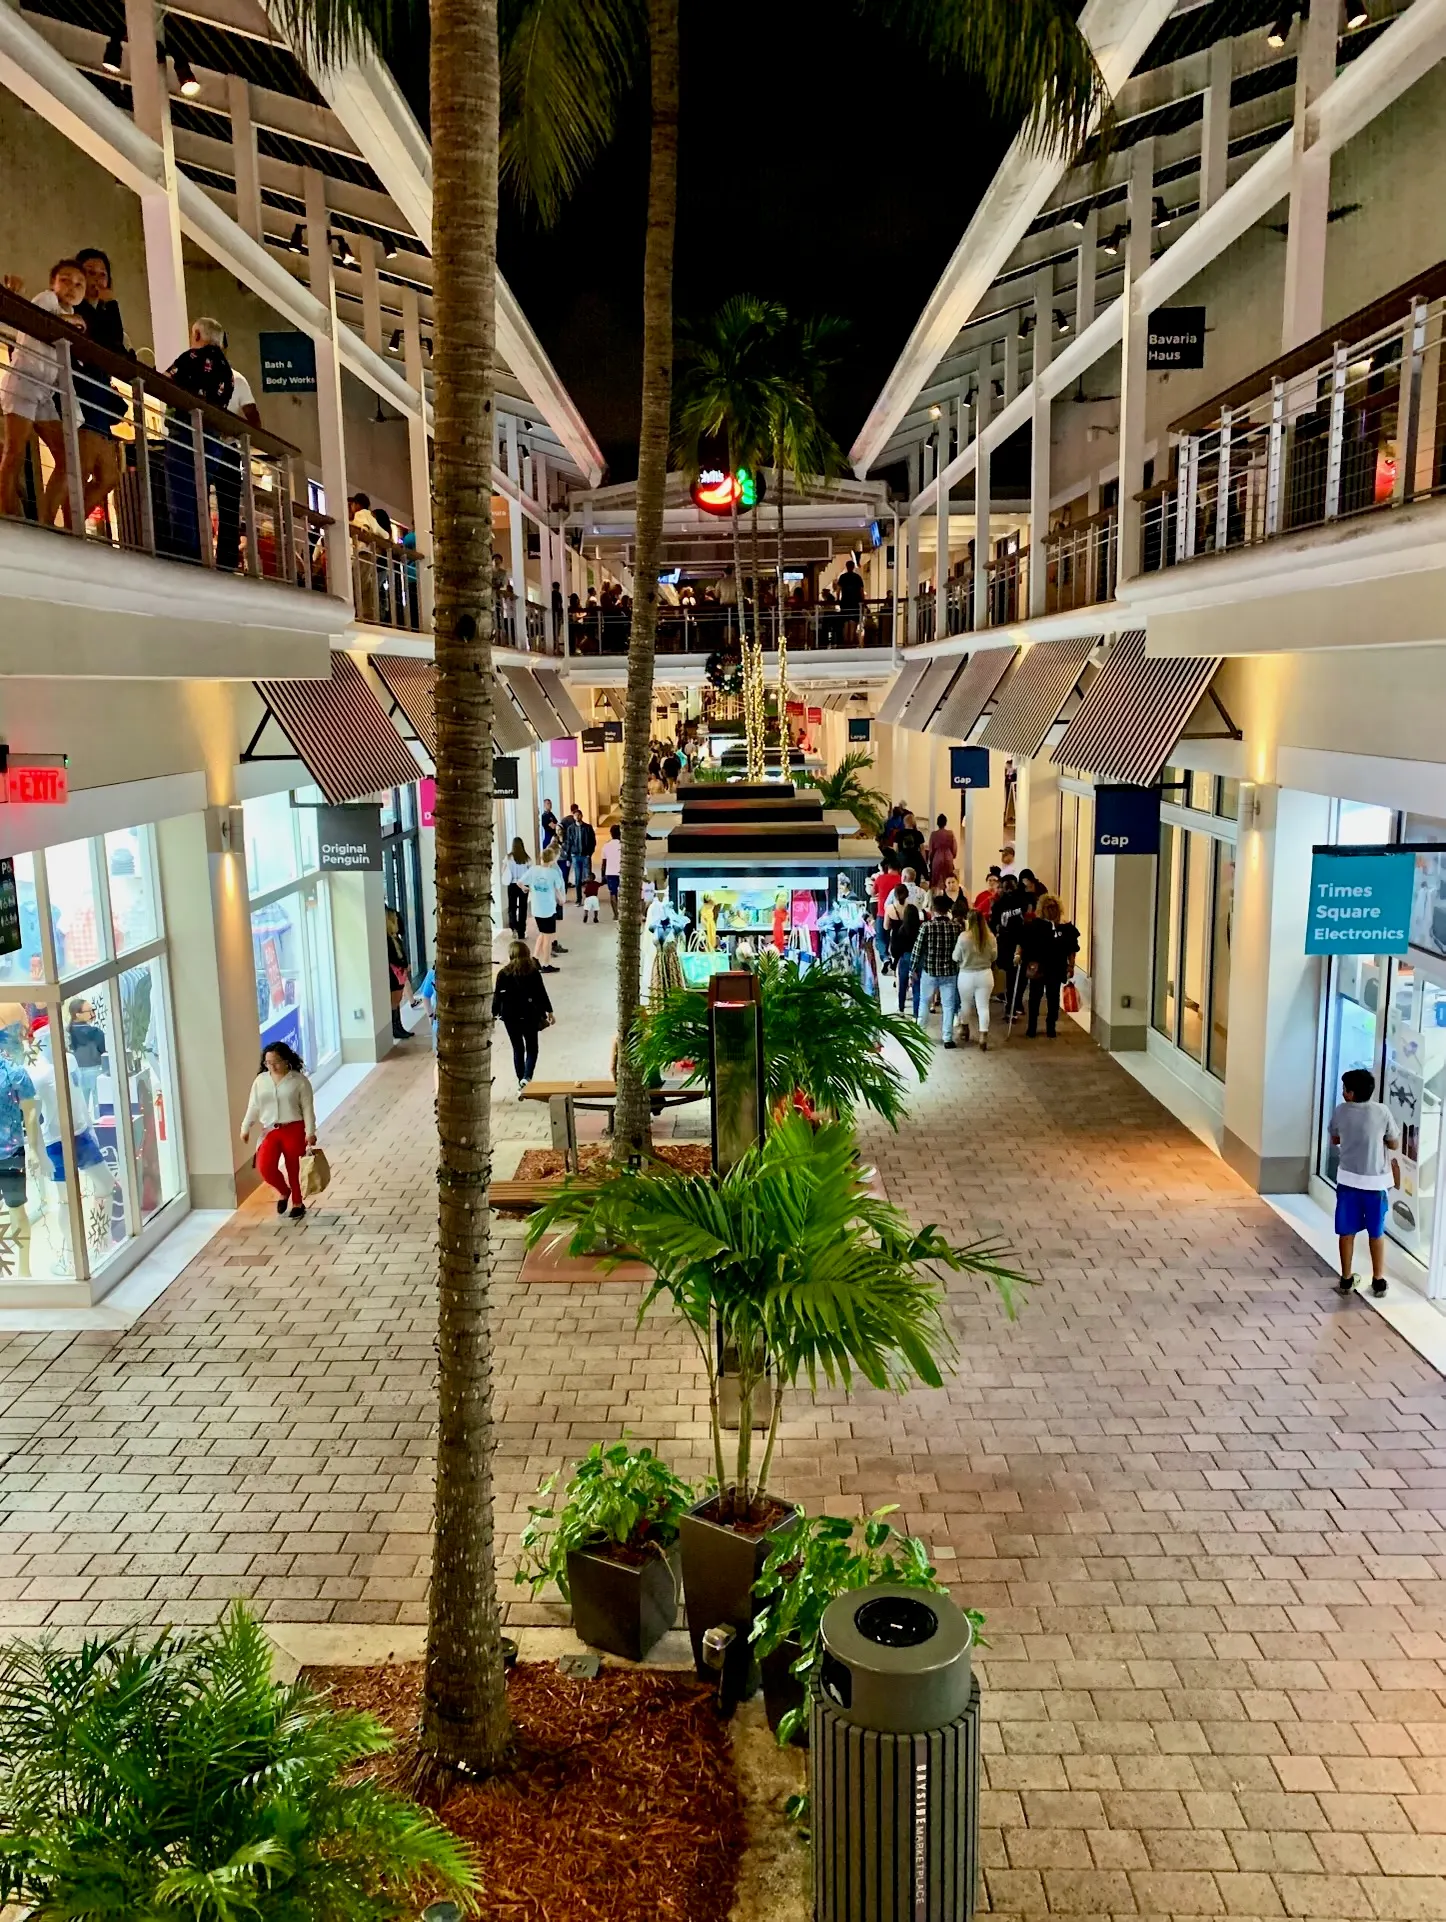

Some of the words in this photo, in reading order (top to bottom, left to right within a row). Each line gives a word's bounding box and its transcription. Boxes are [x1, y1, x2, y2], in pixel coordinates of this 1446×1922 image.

[1149, 332, 1197, 345] Bavaria
[1148, 350, 1181, 361] Haus
[264, 361, 285, 369] Bath
[287, 361, 293, 369] &
[266, 377, 287, 386] Body
[289, 376, 315, 384] Works
[19, 770, 58, 802] EXIT
[953, 776, 972, 785] Gap
[1100, 834, 1129, 848] Gap
[321, 843, 367, 855] Original
[322, 854, 370, 866] Penguin
[1317, 883, 1373, 898] Times
[1315, 905, 1381, 922] Square
[1314, 927, 1404, 940] Electronics
[915, 1764, 927, 1824] BAYSIDE
[915, 1825, 925, 1905] MARKETPLACE
